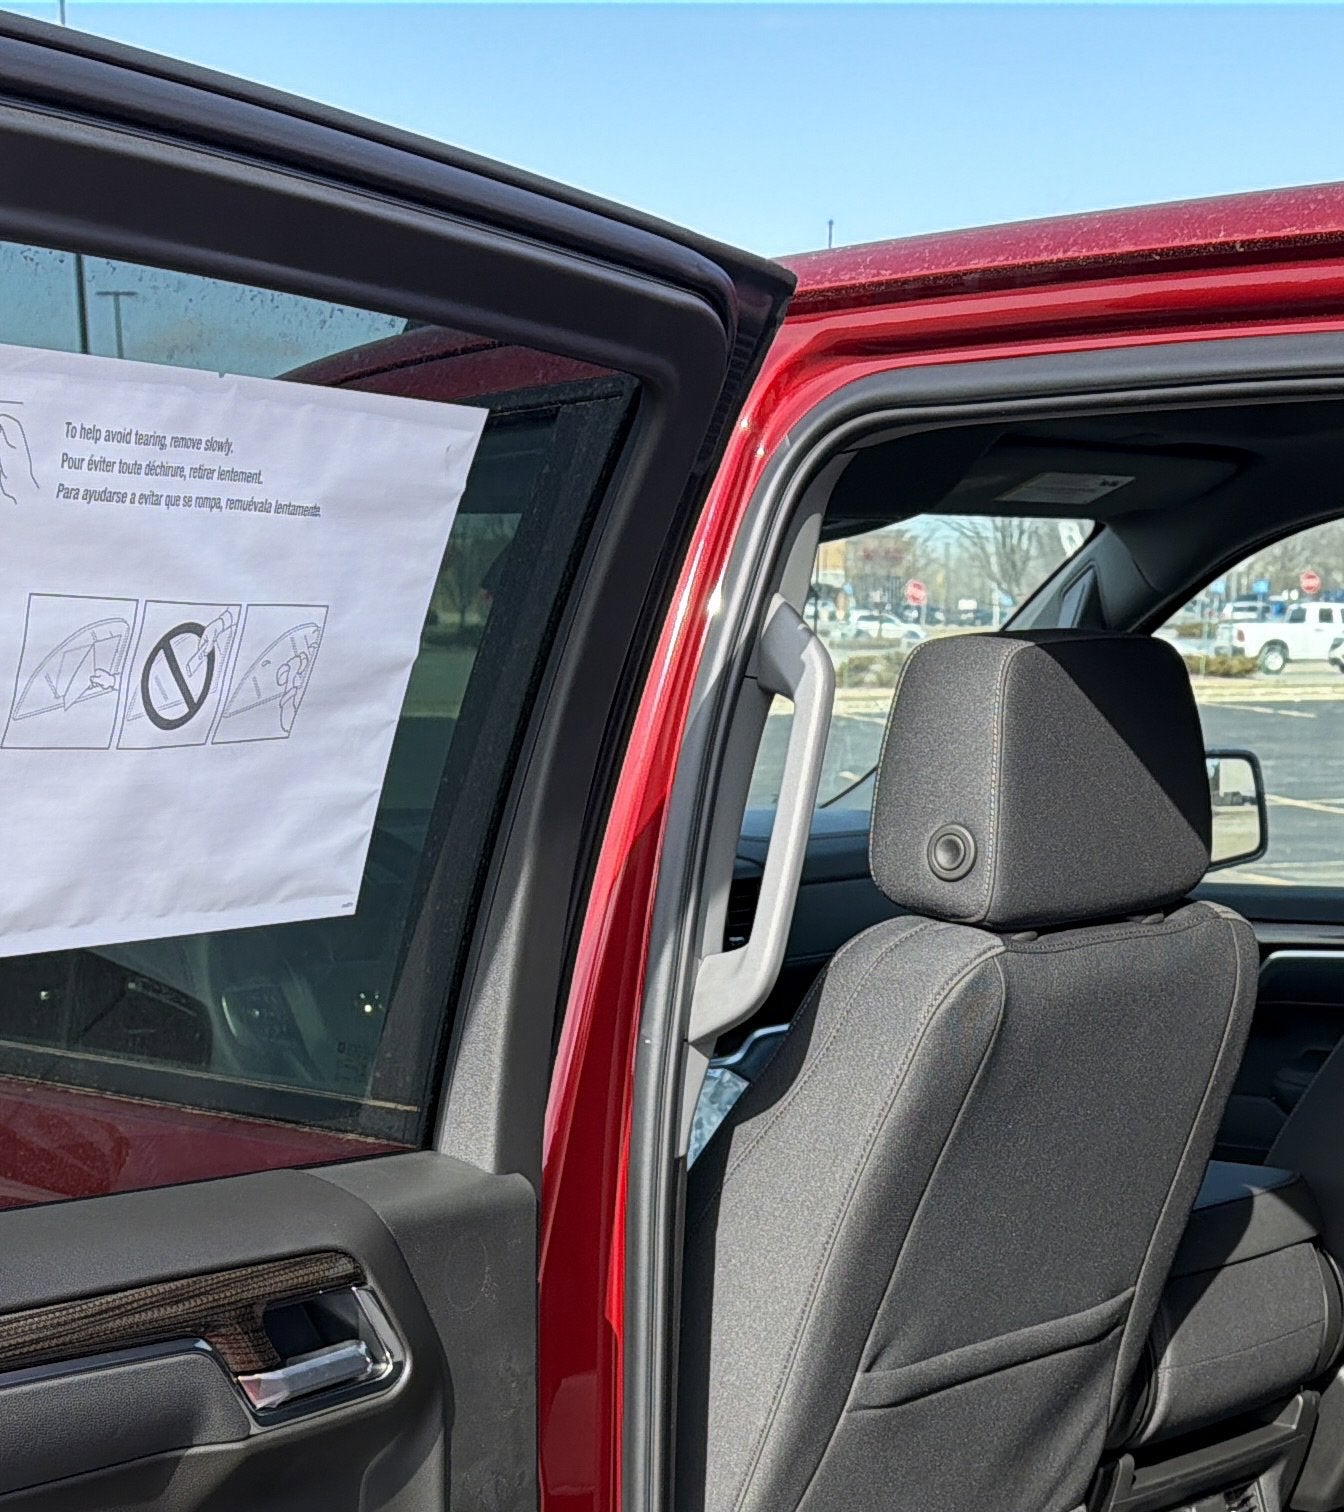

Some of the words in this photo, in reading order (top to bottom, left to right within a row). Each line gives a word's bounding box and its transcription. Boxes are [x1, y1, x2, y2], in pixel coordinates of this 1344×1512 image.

[65, 422, 77, 439] To
[80, 423, 101, 444] help
[104, 428, 132, 444] avoid
[134, 430, 167, 450] tearing,
[170, 435, 202, 450] remove
[204, 436, 233, 456] slowly.
[61, 452, 85, 470] Pour
[87, 453, 116, 473] éviter
[118, 458, 143, 475] toute
[144, 459, 186, 480] déchirure,
[188, 464, 216, 480] retirer
[217, 465, 263, 484] lentement.
[56, 483, 80, 500] Para
[82, 486, 127, 505] ayudarse
[129, 493, 136, 504] a
[138, 490, 164, 508] evitar
[165, 495, 181, 510] que
[182, 495, 192, 508] se
[194, 496, 223, 512] rompa,
[225, 496, 272, 514] remuévala
